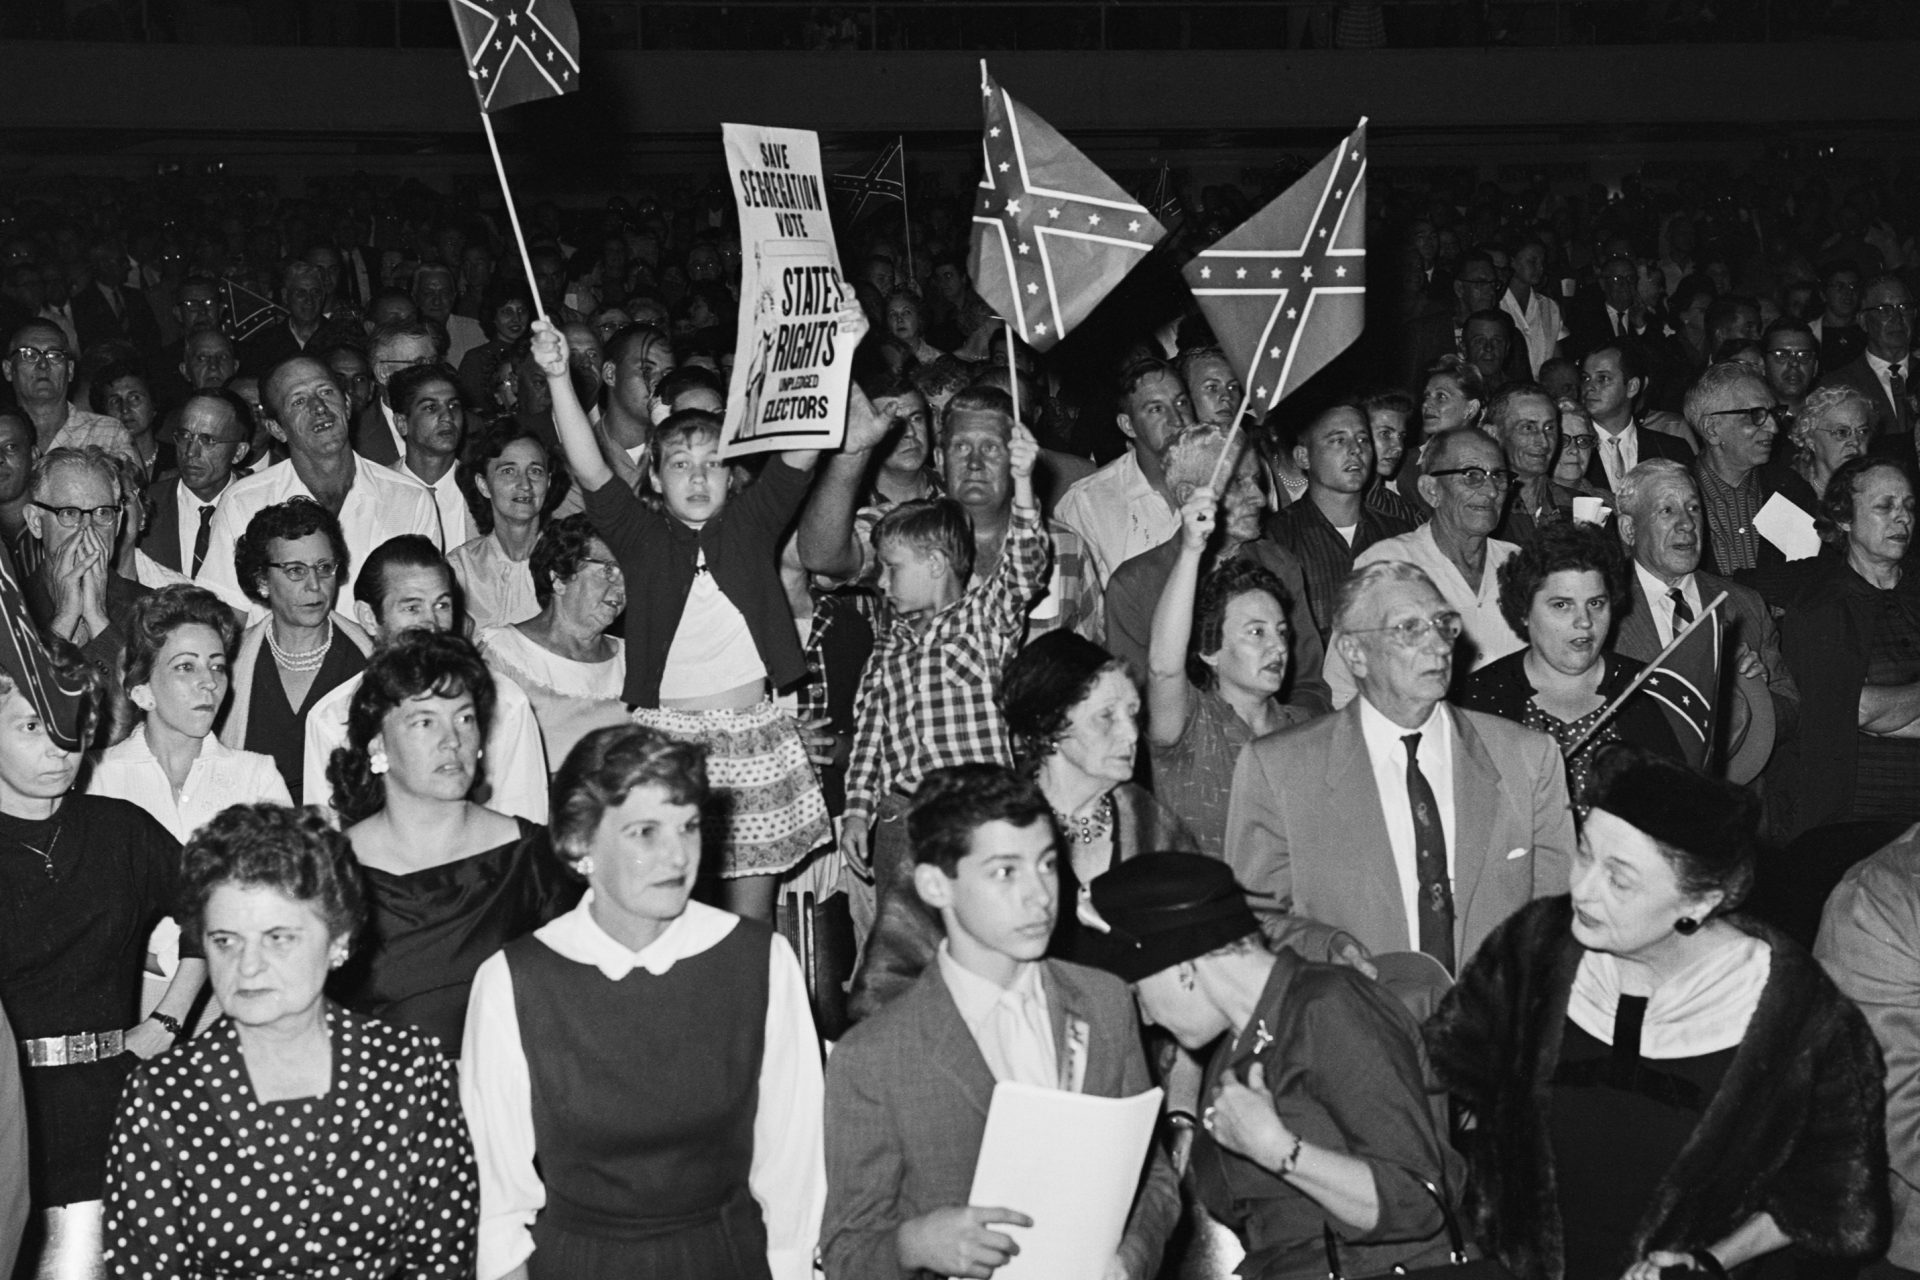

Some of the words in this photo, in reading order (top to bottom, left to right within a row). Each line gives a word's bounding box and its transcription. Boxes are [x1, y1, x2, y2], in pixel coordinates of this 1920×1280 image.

[760, 142, 790, 170] SAVE
[740, 169, 822, 211] SEGREGATION
[775, 212, 808, 238] VOTE
[772, 320, 838, 373] RIGHTS
[778, 374, 819, 392] UNPLEDGED
[761, 395, 829, 424] ELECTORS
